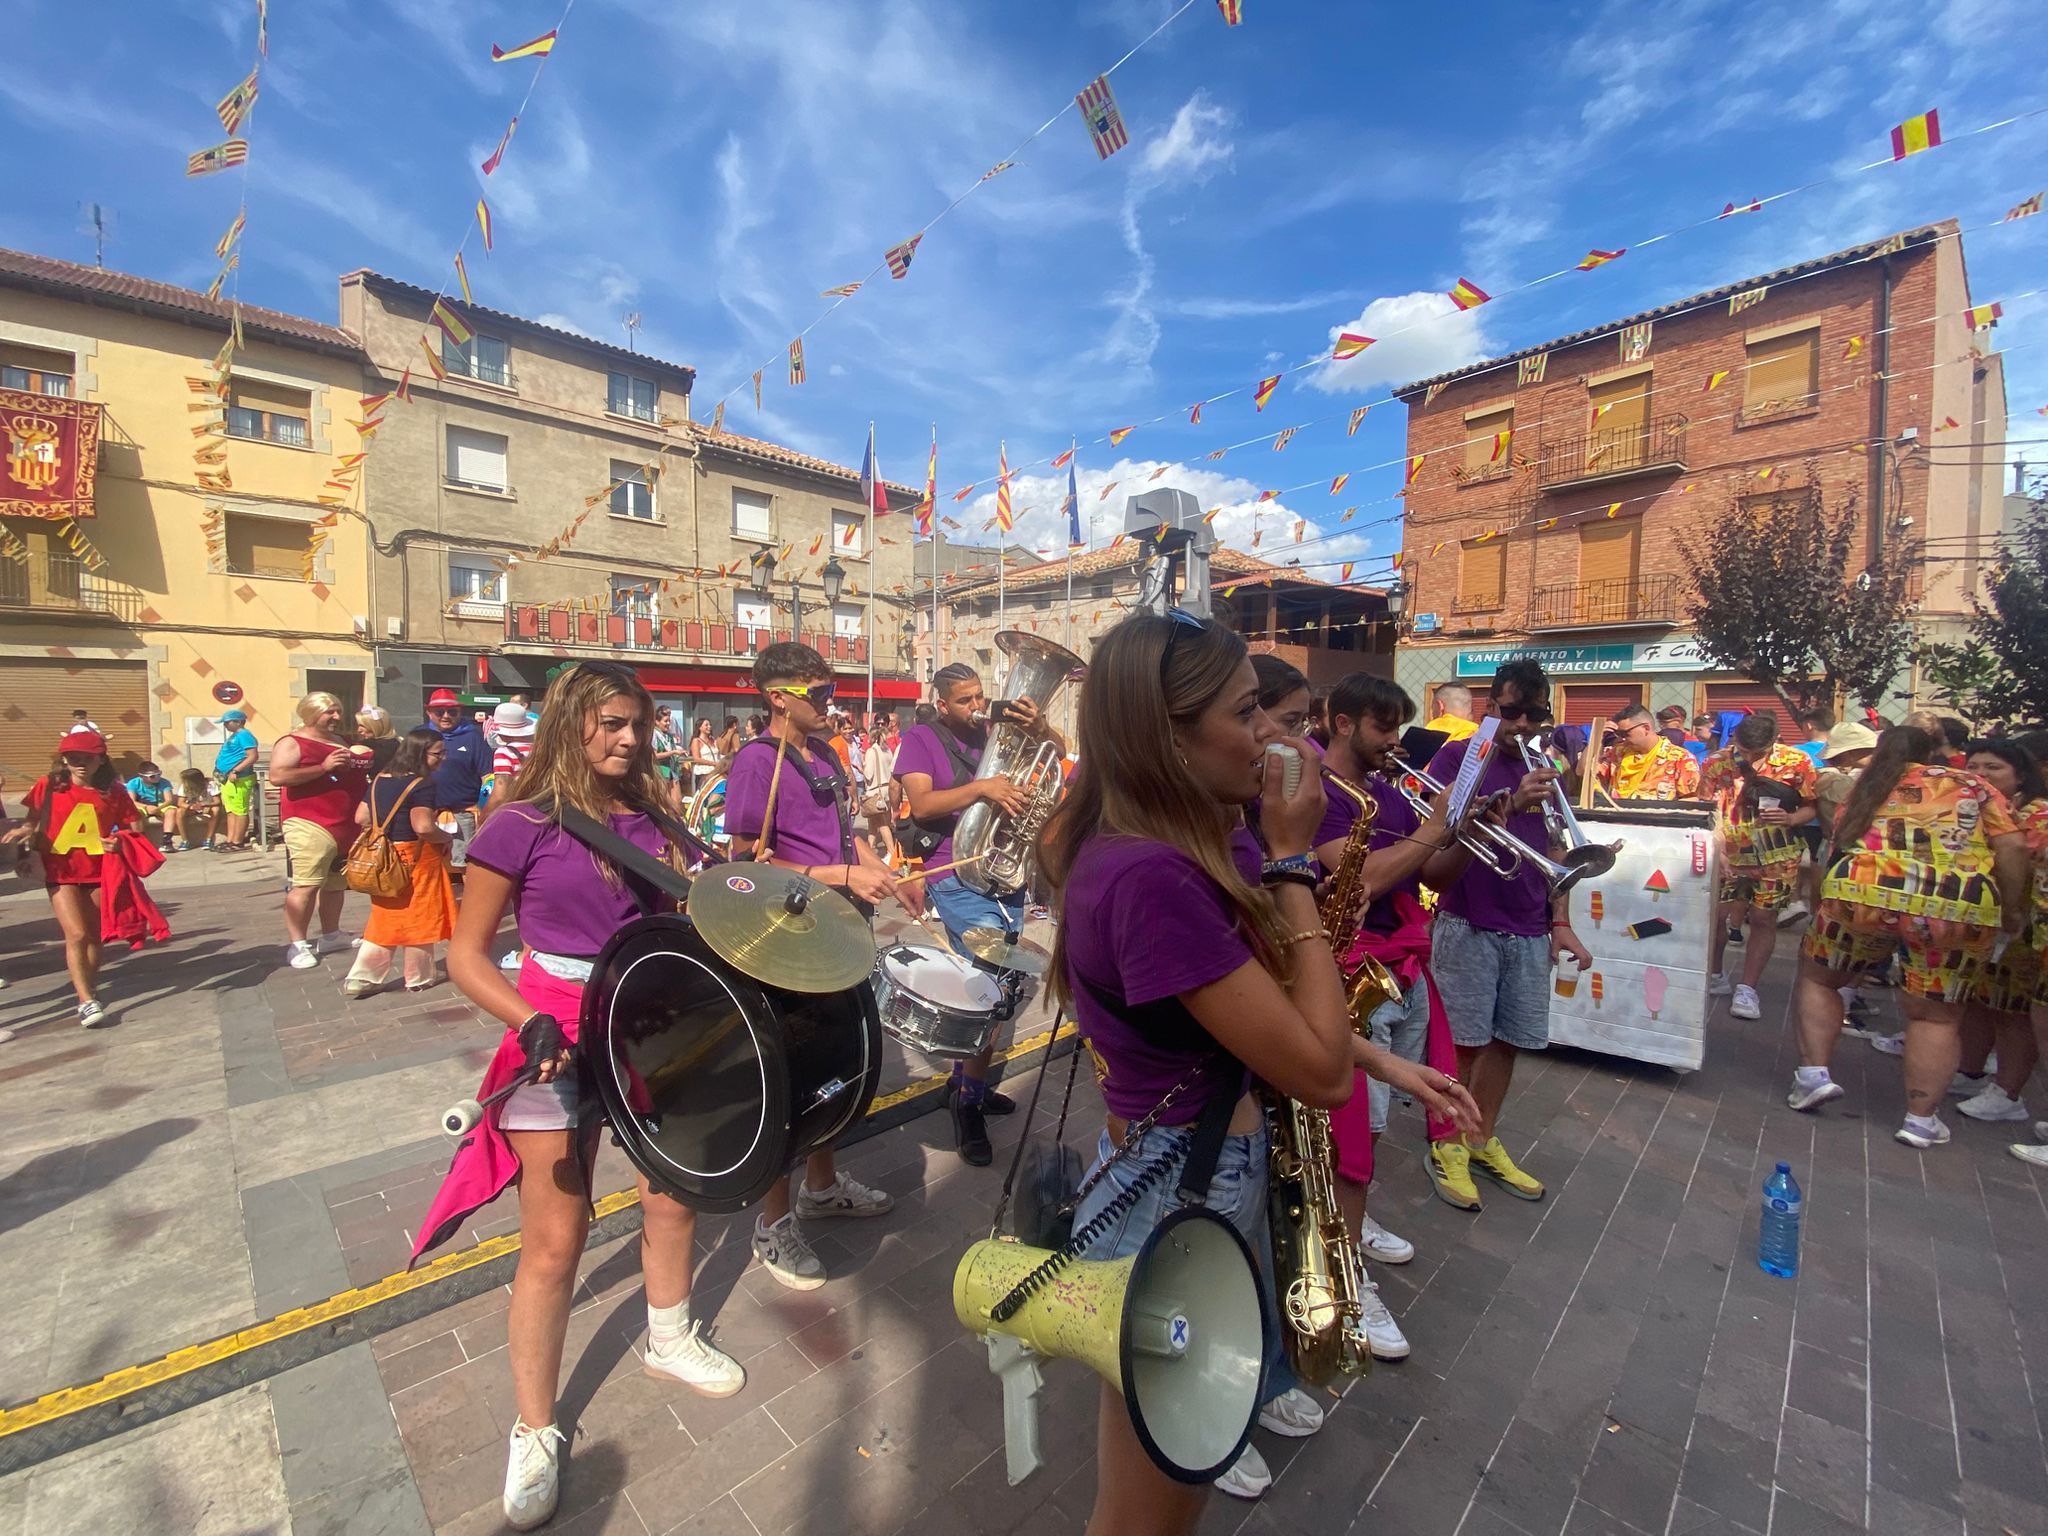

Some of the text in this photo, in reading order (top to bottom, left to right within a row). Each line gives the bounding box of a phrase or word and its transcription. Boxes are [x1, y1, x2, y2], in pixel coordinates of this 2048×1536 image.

[1466, 649, 1585, 663] SANEAMIENTO Y
[1539, 660, 1622, 672] EFACCION
[50, 802, 105, 855] A
